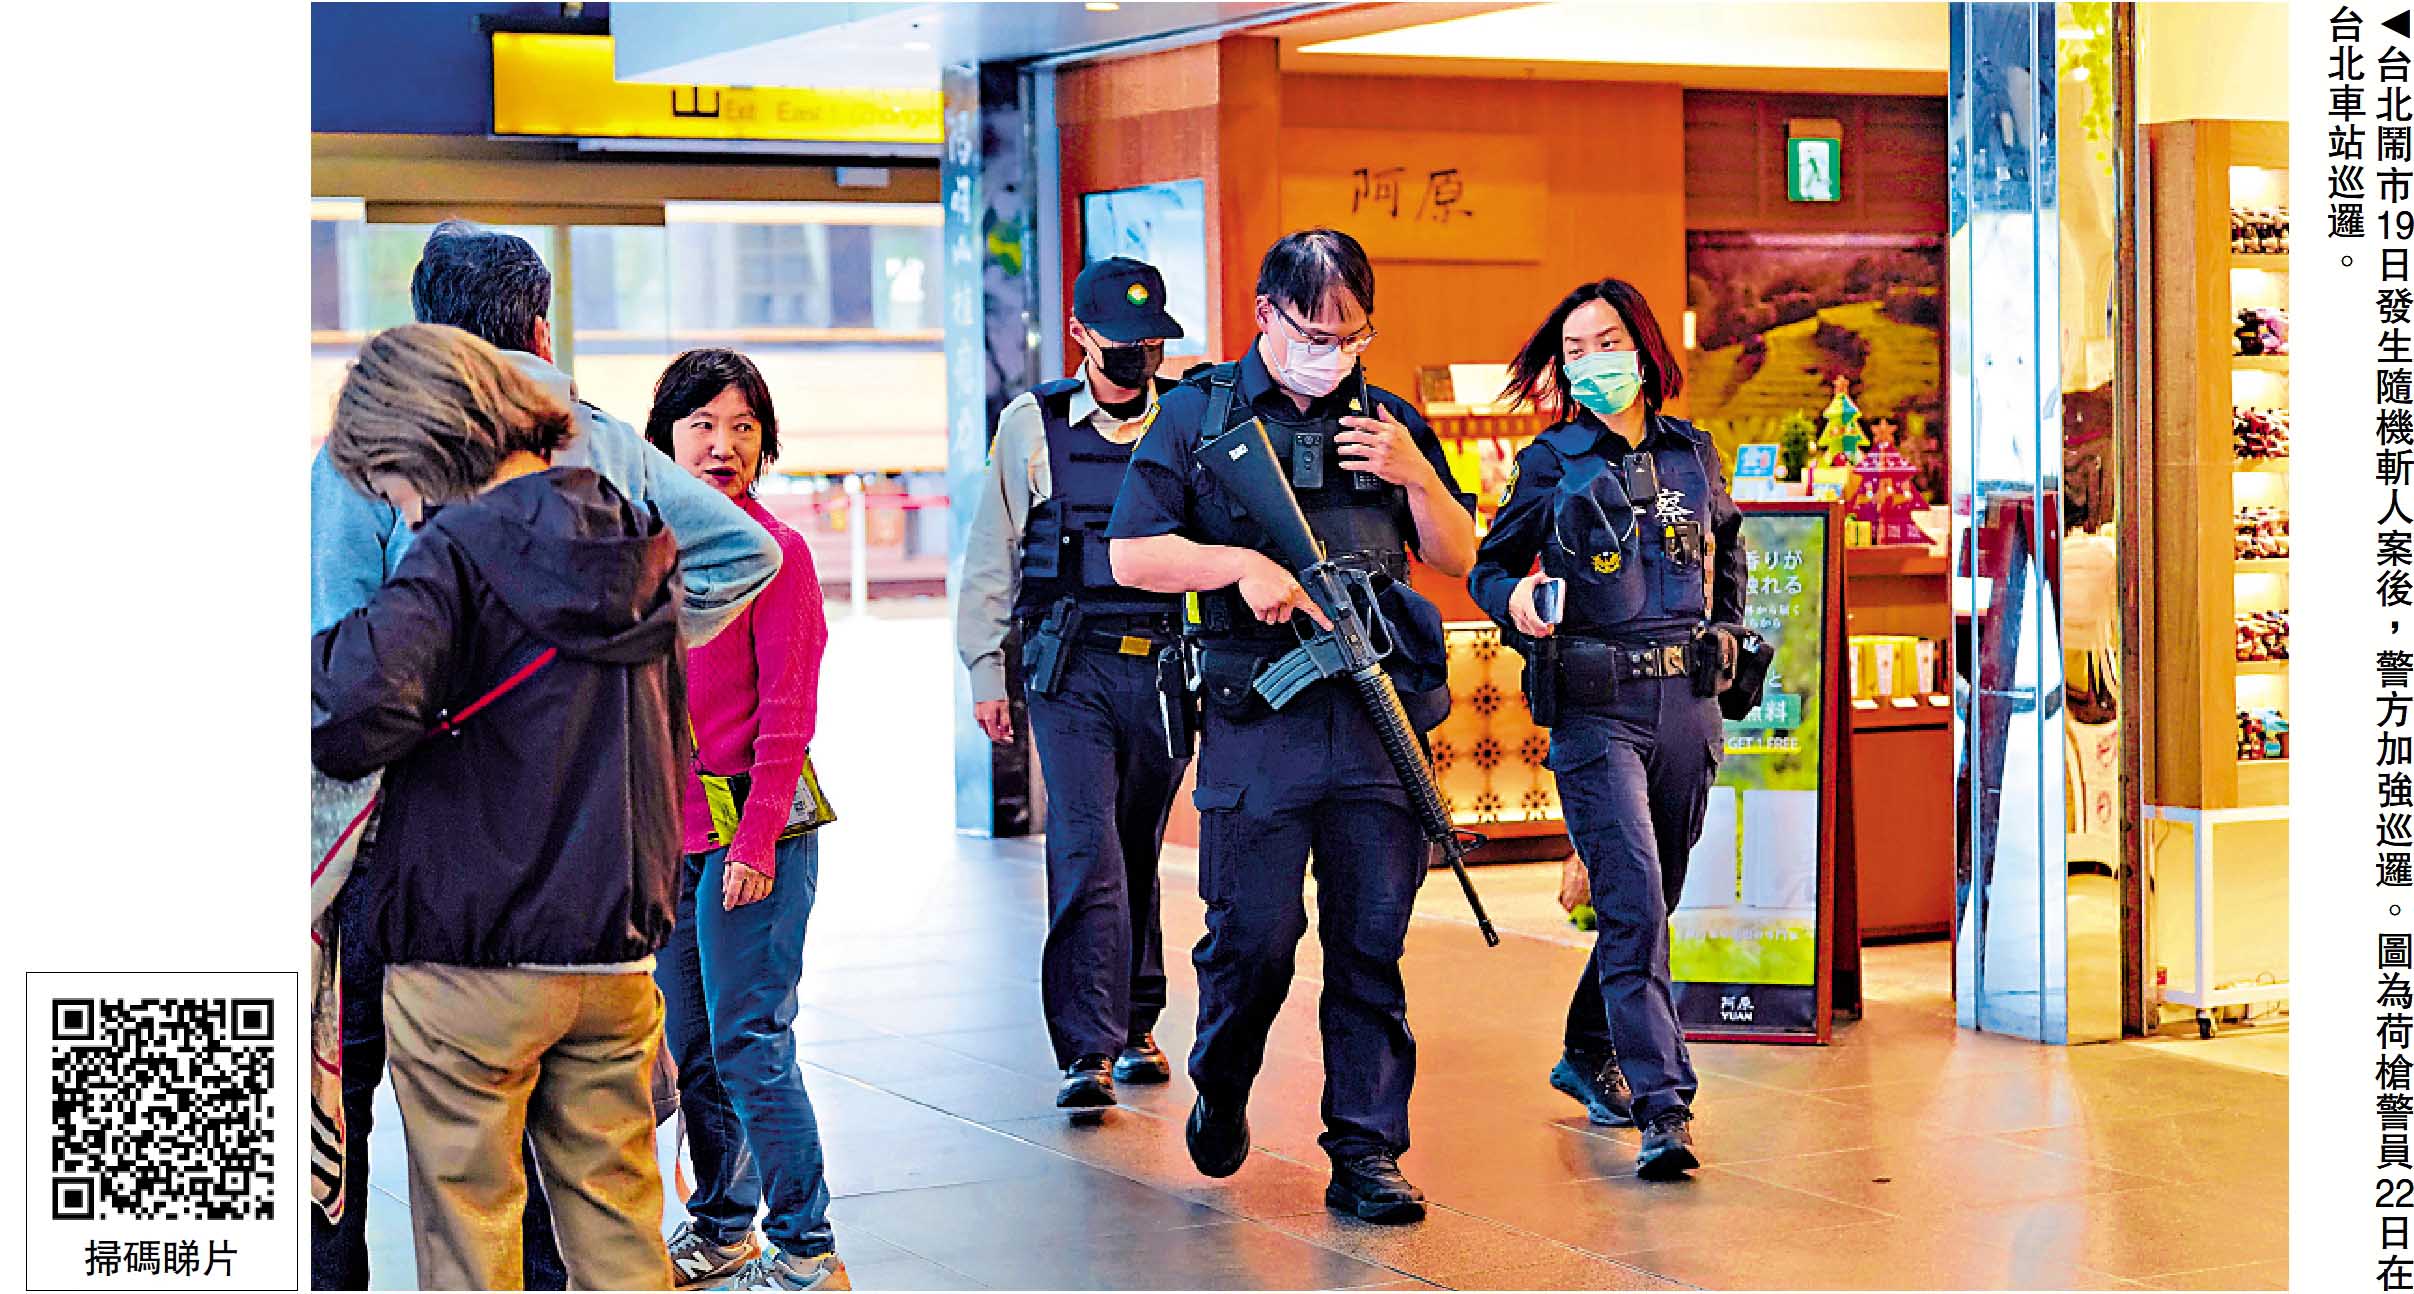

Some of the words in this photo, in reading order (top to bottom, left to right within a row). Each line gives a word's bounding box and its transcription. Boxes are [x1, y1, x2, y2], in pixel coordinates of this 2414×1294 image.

[1352, 166, 1473, 223] 阿原
[1654, 488, 1695, 524] 察
[1727, 736, 1753, 750] GET
[1766, 736, 1799, 750] FREE
[1720, 1011, 1753, 1021] YUAN
